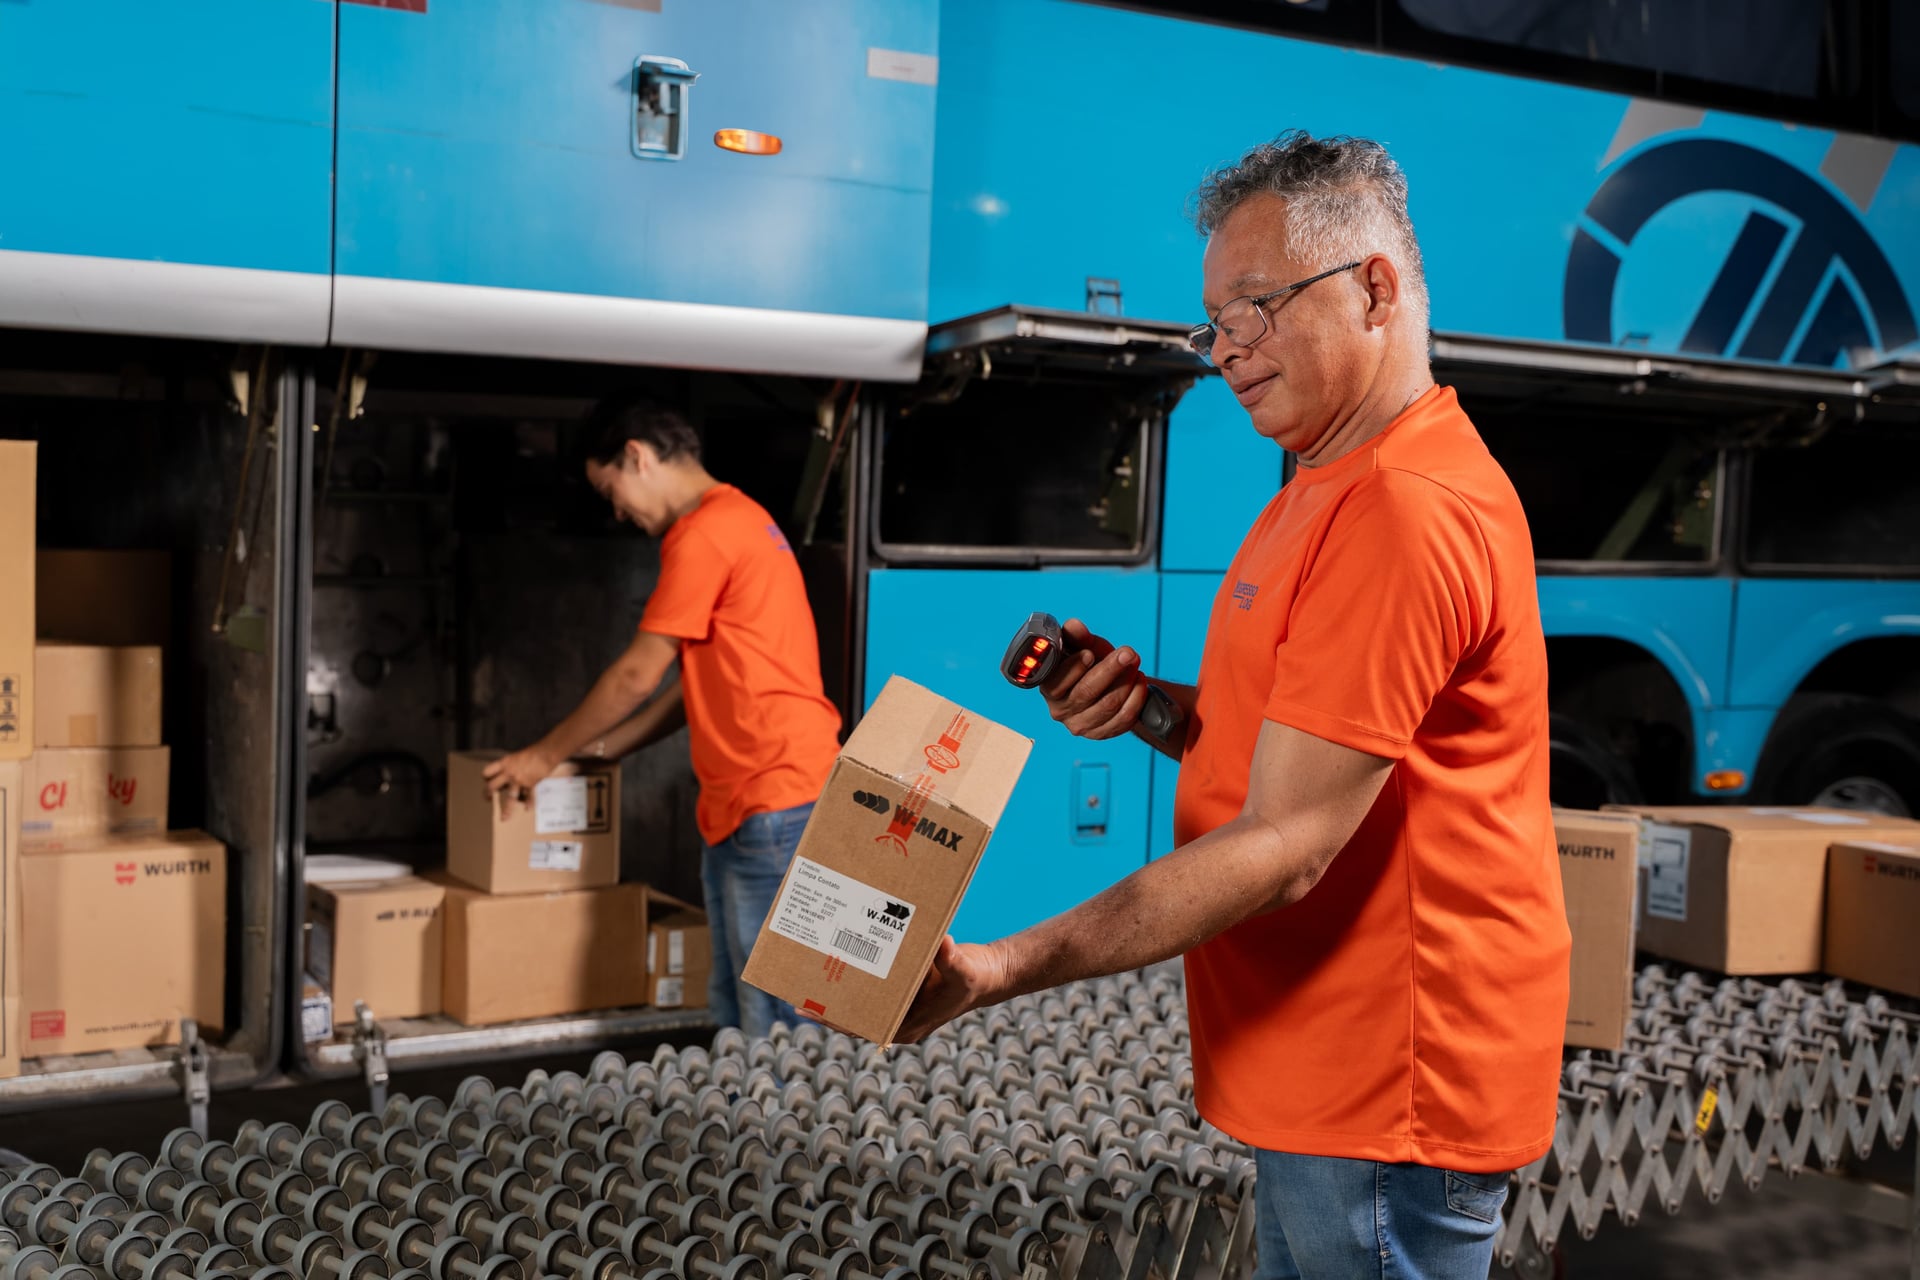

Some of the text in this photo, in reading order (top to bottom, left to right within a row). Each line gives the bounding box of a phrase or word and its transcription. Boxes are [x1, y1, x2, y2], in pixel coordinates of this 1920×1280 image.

[893, 804, 963, 852] W-MAX
[798, 868, 841, 890] Limpa Contato
[867, 908, 906, 932] W-MAX
